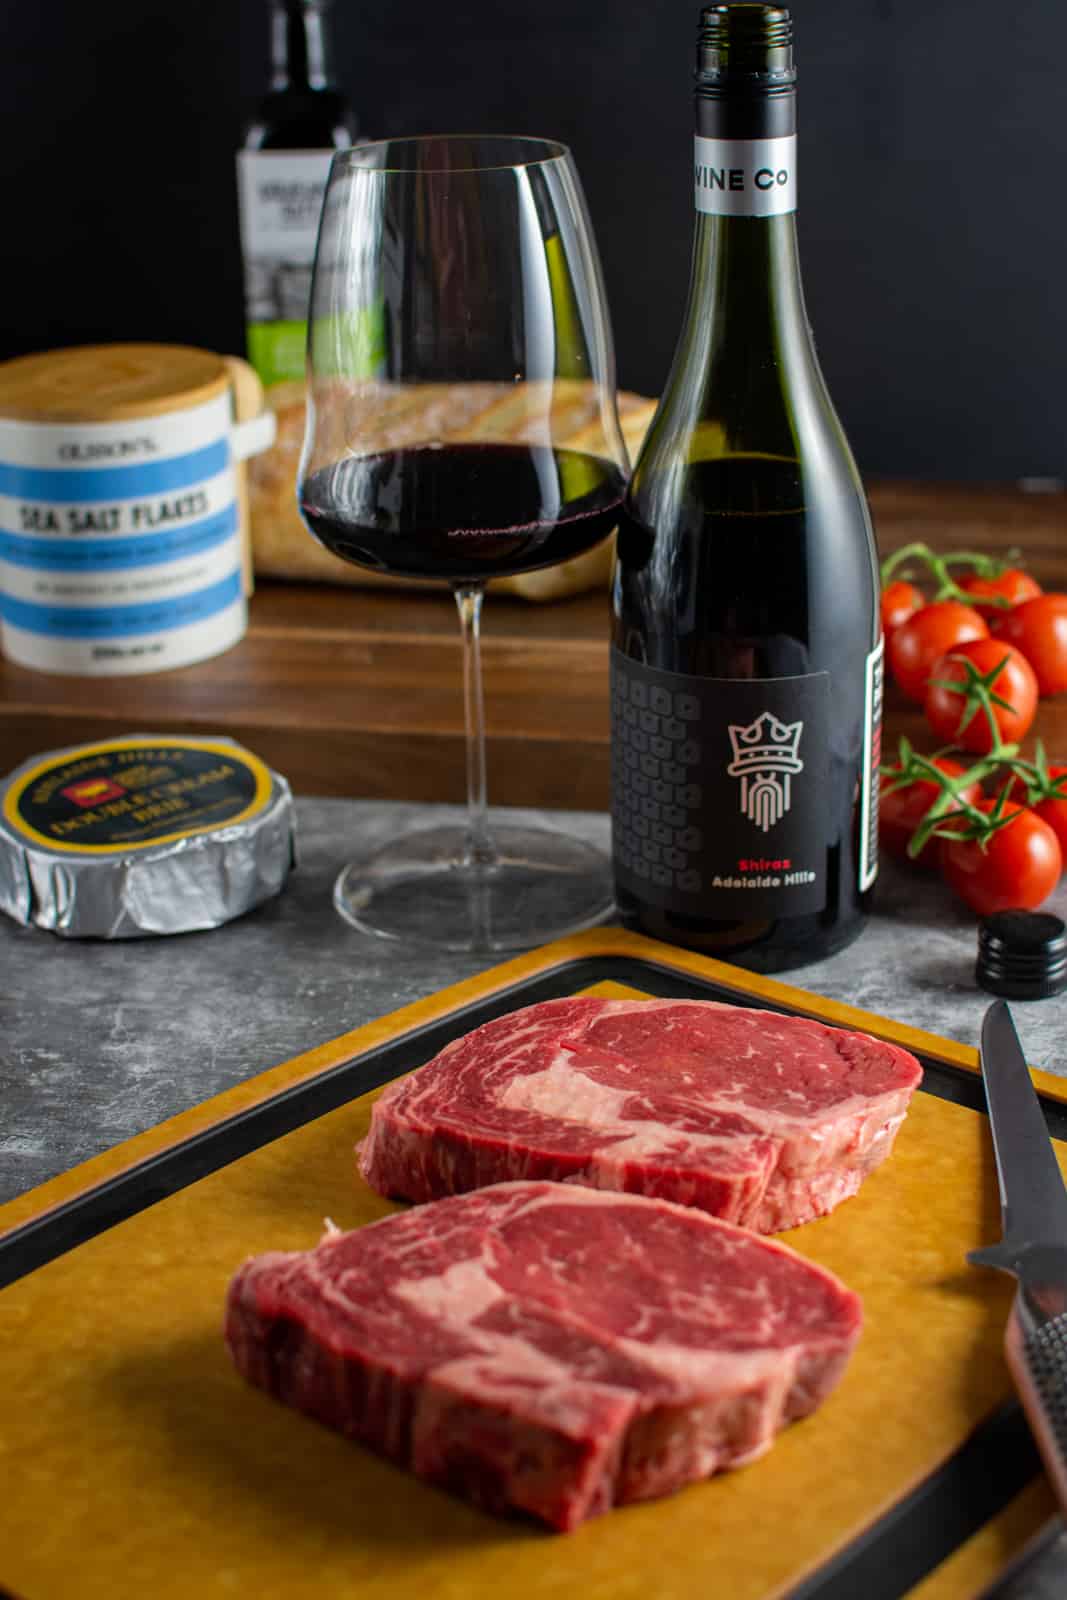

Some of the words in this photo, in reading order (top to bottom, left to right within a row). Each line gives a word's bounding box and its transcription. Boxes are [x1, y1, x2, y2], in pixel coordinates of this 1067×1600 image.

[20, 506, 60, 531] SEA
[68, 506, 121, 532] SALT
[131, 492, 208, 528] FLAKES
[738, 859, 791, 872] Shiraz
[712, 876, 781, 888] Adelaide
[784, 871, 817, 886] Hills
